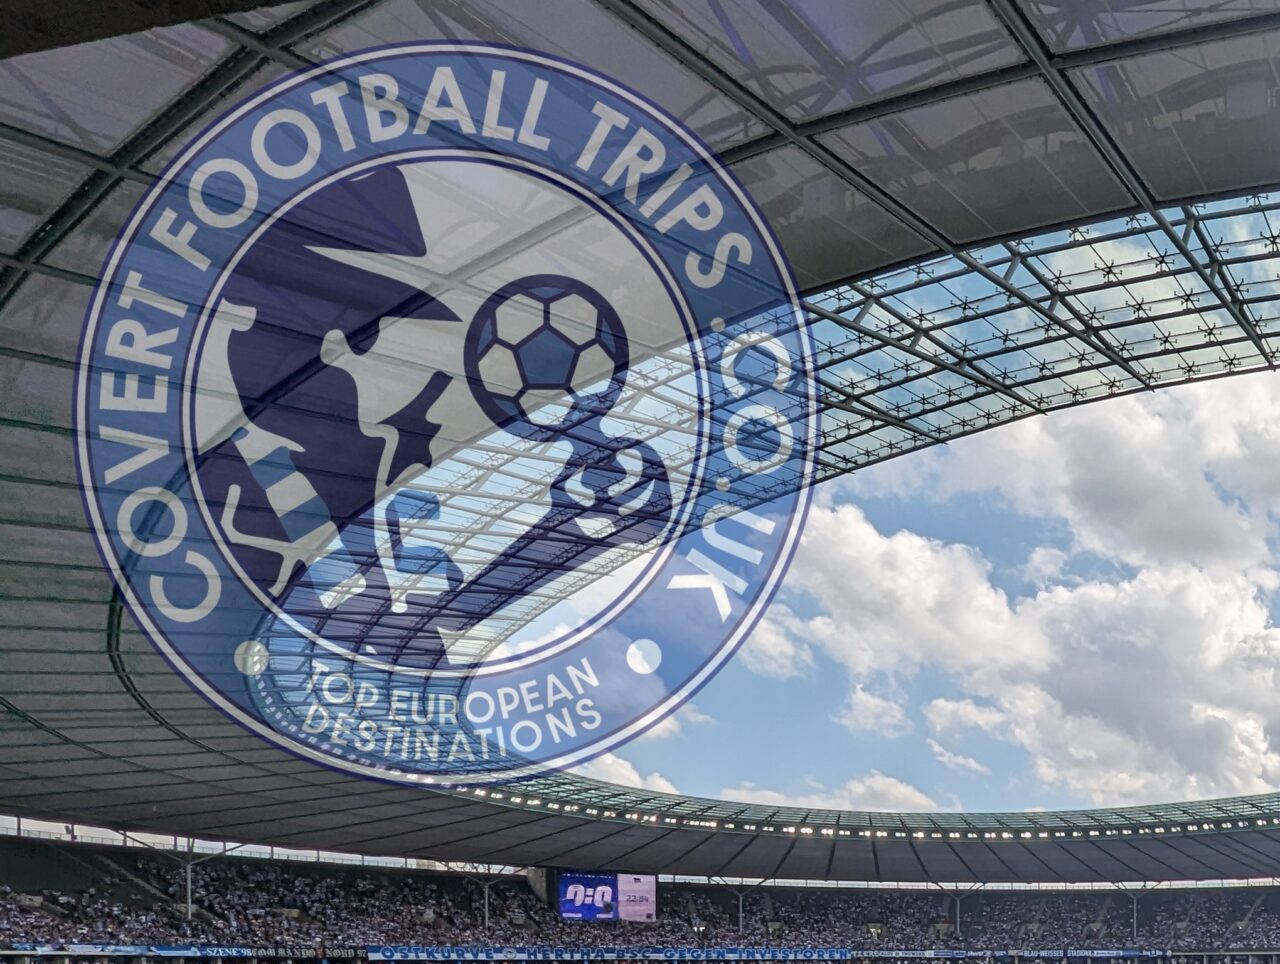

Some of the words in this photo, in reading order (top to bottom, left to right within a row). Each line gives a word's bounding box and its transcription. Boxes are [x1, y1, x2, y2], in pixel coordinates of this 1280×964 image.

[381, 947, 494, 960] OSTKURVE
[527, 947, 605, 960] HERTHA
[616, 948, 650, 959] BSC
[664, 948, 726, 959] GEGEN
[738, 948, 849, 959] INVESTOREN
